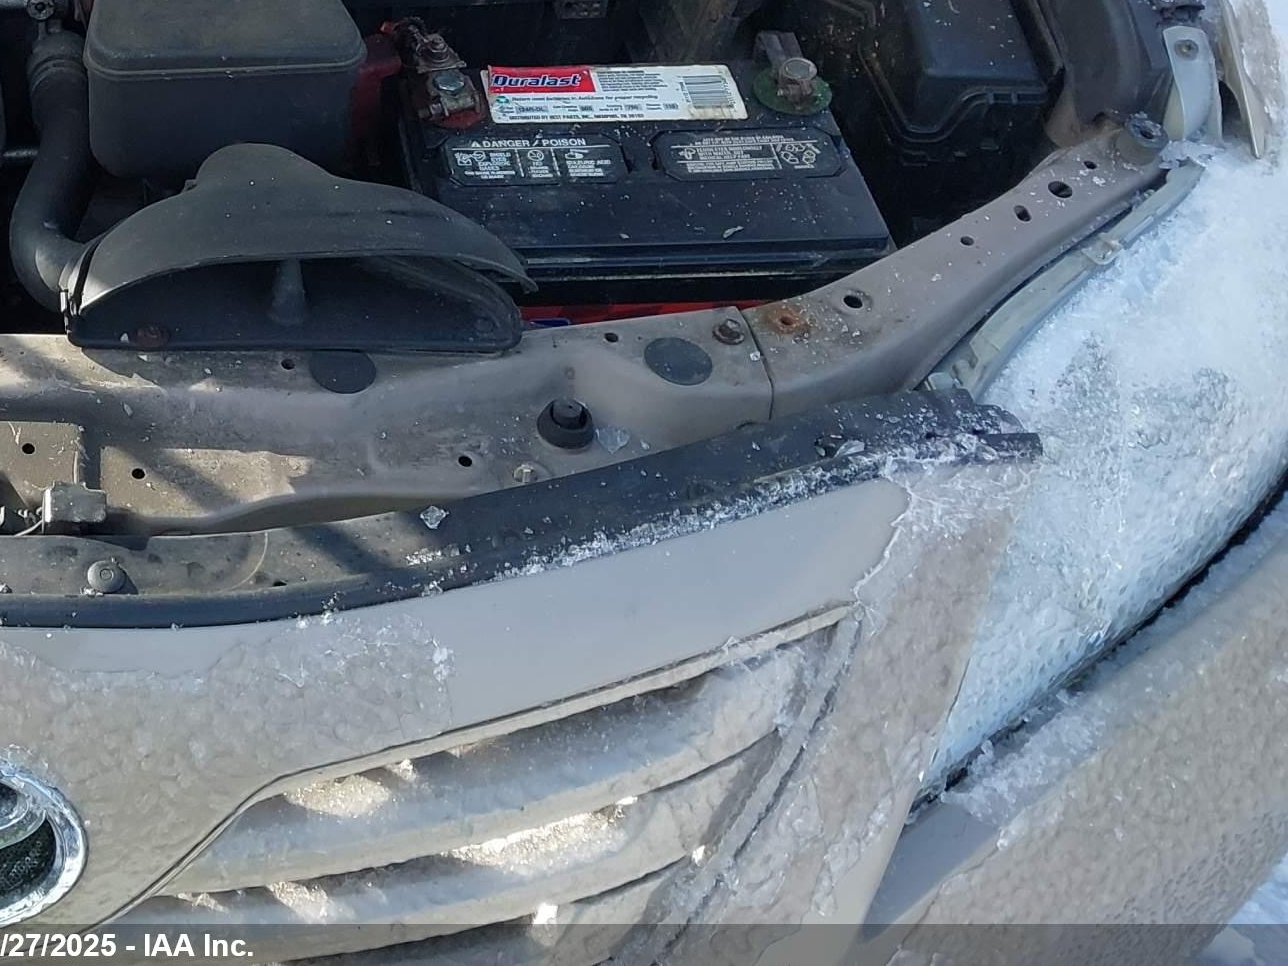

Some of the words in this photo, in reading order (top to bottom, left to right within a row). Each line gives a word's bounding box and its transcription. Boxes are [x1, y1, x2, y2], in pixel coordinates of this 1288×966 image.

[492, 73, 582, 87] Duralast
[482, 139, 530, 148] DANGER
[542, 138, 586, 146] POISON
